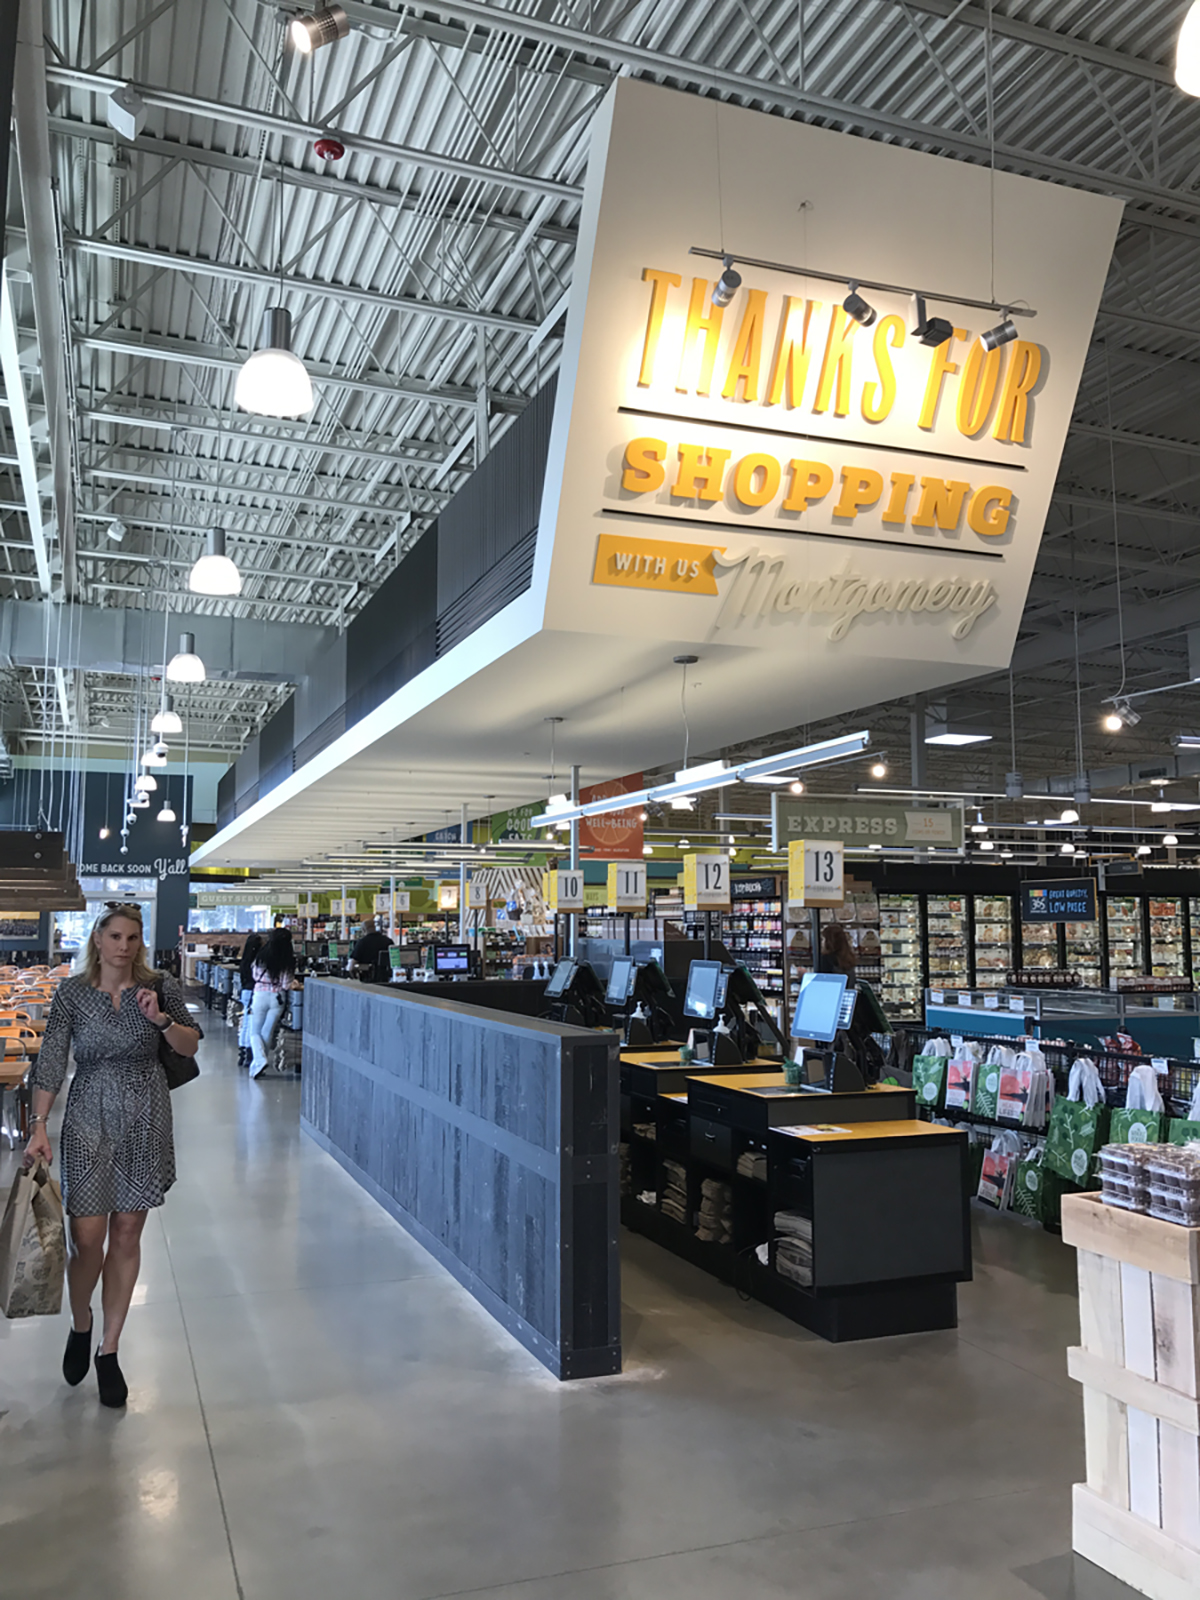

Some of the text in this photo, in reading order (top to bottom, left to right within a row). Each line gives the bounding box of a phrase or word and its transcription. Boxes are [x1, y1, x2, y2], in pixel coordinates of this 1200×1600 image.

[637, 268, 1042, 443] THANKS FOR
[622, 437, 1013, 536] SHOPPING
[614, 551, 700, 578] WITH US
[711, 546, 999, 642] Montgomery
[506, 817, 533, 832] GOOD
[787, 815, 934, 835] EXPRESS 15
[79, 858, 188, 881] OME BACK SOON Y'all
[704, 863, 722, 890] 12
[815, 850, 834, 883] 13
[475, 886, 481, 900] 8
[564, 876, 578, 898] 10
[625, 870, 638, 895] 11
[201, 894, 277, 903] GUEST SERVICE
[1031, 897, 1046, 910] 365
[1049, 901, 1087, 913] LOW PRICE
